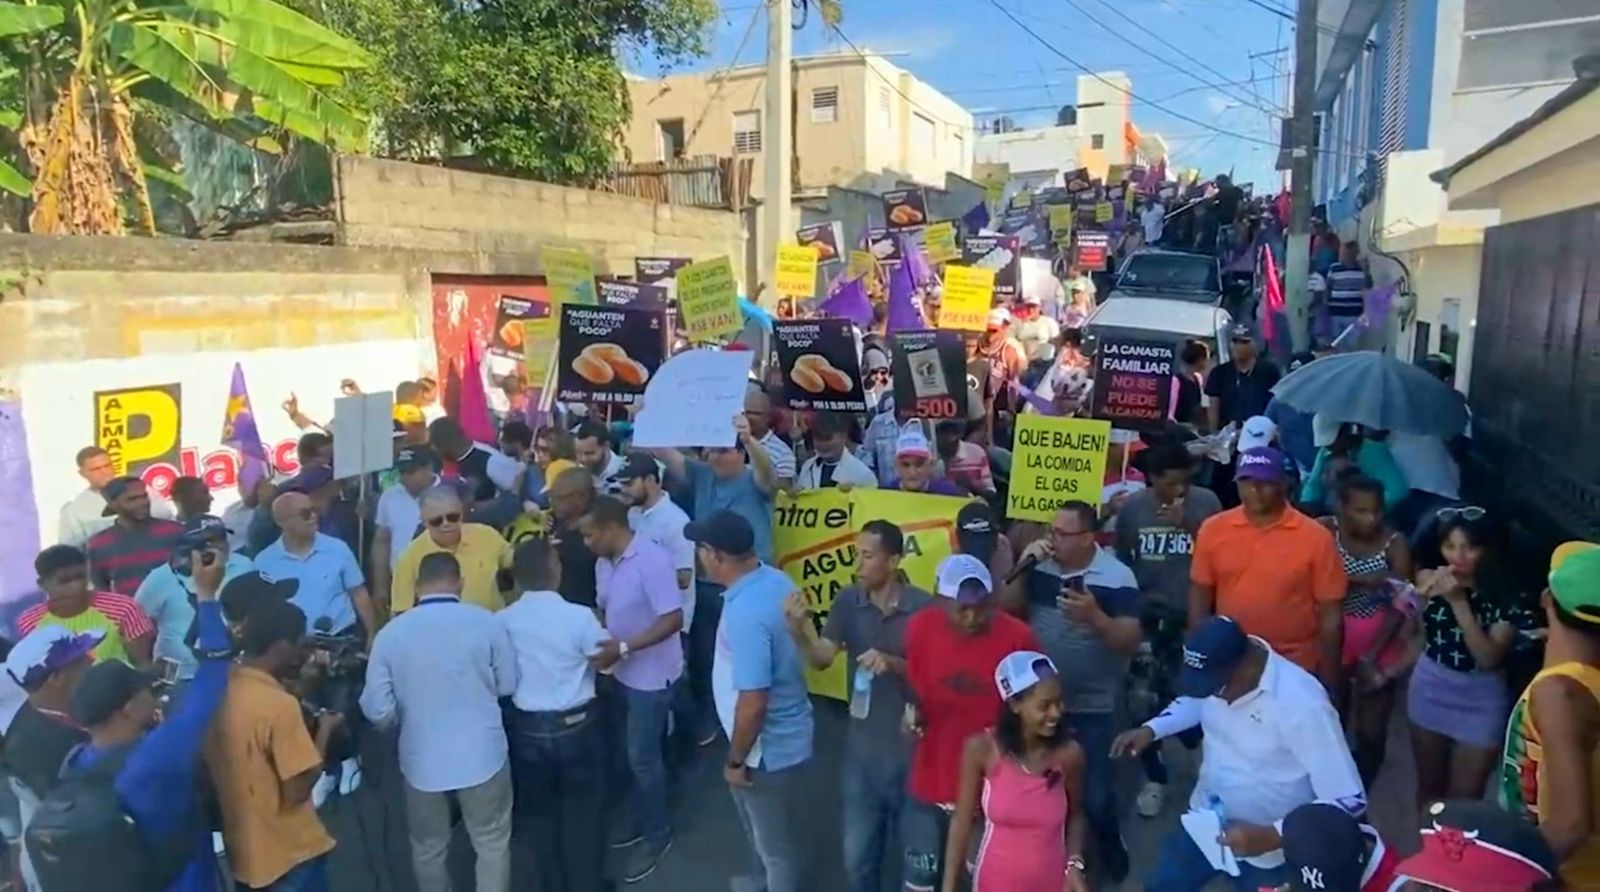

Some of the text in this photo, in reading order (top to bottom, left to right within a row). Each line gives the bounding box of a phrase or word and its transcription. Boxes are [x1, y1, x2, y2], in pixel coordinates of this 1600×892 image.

[592, 320, 622, 329] FALTA
[1104, 344, 1173, 359] LA CANASTA
[1102, 358, 1171, 375] FAMILIAR
[1111, 374, 1158, 390] NO SE
[916, 398, 957, 417] 500
[1107, 392, 1158, 407] PUEDE
[1019, 429, 1105, 452] QUE BAJEN!
[1026, 453, 1092, 473] LA COMIDA
[1035, 476, 1078, 493] EL GAS
[1011, 495, 1020, 509] Y
[1020, 496, 1036, 510] LA
[824, 502, 855, 529] el
[1300, 865, 1325, 889] NY
